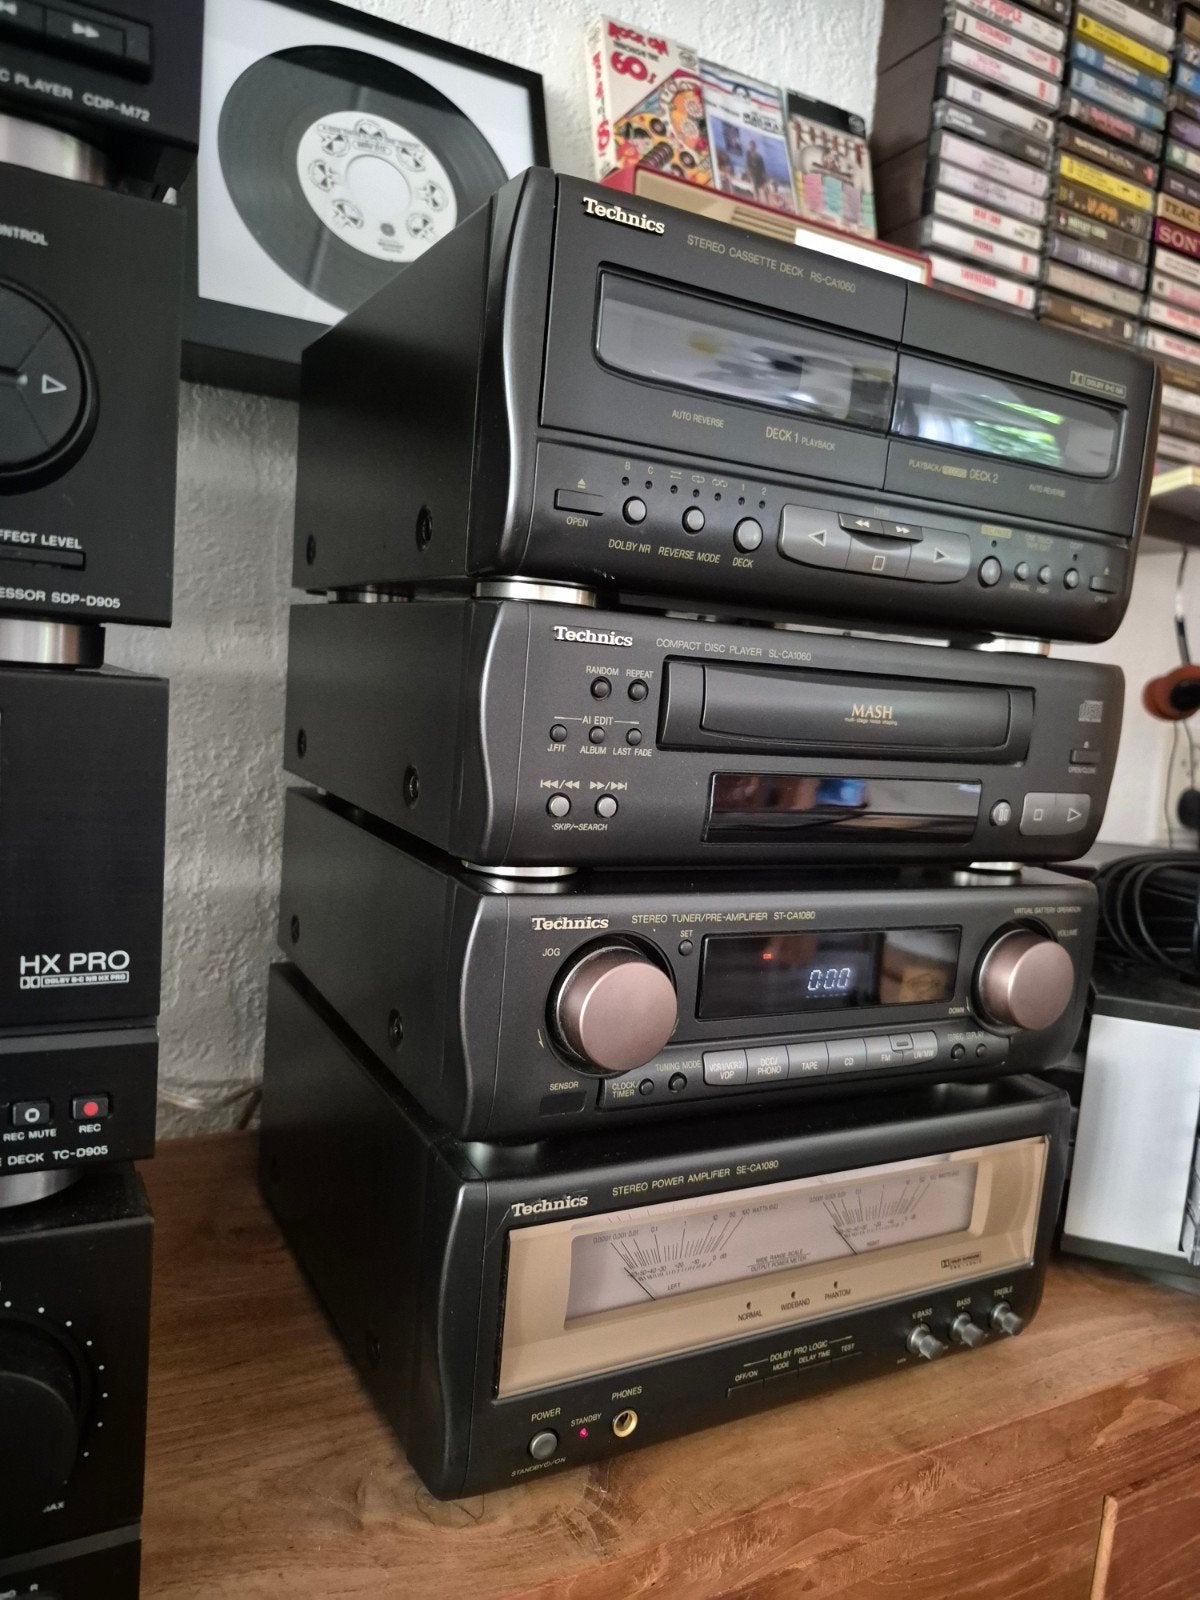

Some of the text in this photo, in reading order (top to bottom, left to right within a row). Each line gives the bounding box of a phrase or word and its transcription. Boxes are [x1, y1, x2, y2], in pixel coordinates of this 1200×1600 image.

[14, 72, 73, 100] PLAYER
[83, 92, 150, 122] CDP-M72
[583, 197, 665, 235] Technics
[1159, 224, 1200, 253] SON
[687, 234, 856, 294] STEREO CASSETTE DECK RS-CA1060
[672, 409, 724, 428] AUTO REVERSE
[765, 426, 836, 451] DECK 1 PLAYBACK
[625, 461, 654, 475] B C
[969, 469, 992, 482] DECK
[993, 474, 999, 484] 2
[761, 487, 767, 495] 2
[566, 517, 588, 527] OPEN
[41, 533, 82, 549] LEVEL
[608, 539, 651, 554] DOLBY NR
[658, 546, 721, 565] REVERSE MODE
[732, 557, 753, 569] DECK
[51, 592, 120, 608] SDP-D905
[554, 625, 633, 647] Technics
[656, 638, 812, 661] COMPACT DISC PLAYER SL-CA1060
[586, 665, 653, 679] RANDOM REPEAT
[851, 703, 893, 719] MASH
[594, 716, 614, 725] EDIT
[580, 746, 607, 755] ALBUM
[612, 747, 652, 758] LAST FADE
[532, 915, 609, 931] Technics
[631, 910, 816, 924] STEREO TUNER/PRE-AMPLIFIER ST-CA1080
[680, 930, 693, 938] SET
[1057, 928, 1078, 937] VOLUME
[542, 948, 560, 957] JOG
[20, 950, 130, 975] HX PRO
[807, 967, 851, 991] 0:00
[844, 1057, 854, 1066] CD
[881, 1054, 891, 1062] FM
[655, 1061, 702, 1072] TUNING MODE
[757, 1065, 782, 1076] PHONO
[801, 1061, 818, 1071] TAPE
[720, 1071, 734, 1080] VDP
[549, 1081, 579, 1091] SENSOR
[612, 1089, 635, 1098] TIMER
[3, 1128, 57, 1142] REC MUTE
[78, 1123, 102, 1133] REC
[7, 1145, 109, 1166] DECK TC-D905
[612, 1160, 779, 1197] STEREO POWER AMPLIFIER SE-CA1080
[511, 1195, 589, 1217] Technics
[667, 1282, 681, 1291] LEFT
[824, 1288, 851, 1301] PHANTOM
[780, 1298, 811, 1311] WIDEBAND
[956, 1297, 971, 1308] BASS
[737, 1310, 763, 1321] NORMAL
[769, 1339, 829, 1362] DOLBY PRO LOGIC
[841, 1342, 855, 1352] TEST
[798, 1349, 831, 1364] DELAY TIME
[773, 1361, 790, 1372] MODE
[735, 1370, 758, 1381] OFF/ON
[611, 1386, 643, 1401] PHONES
[531, 1407, 561, 1422] POWER
[570, 1412, 602, 1427] STANDBY
